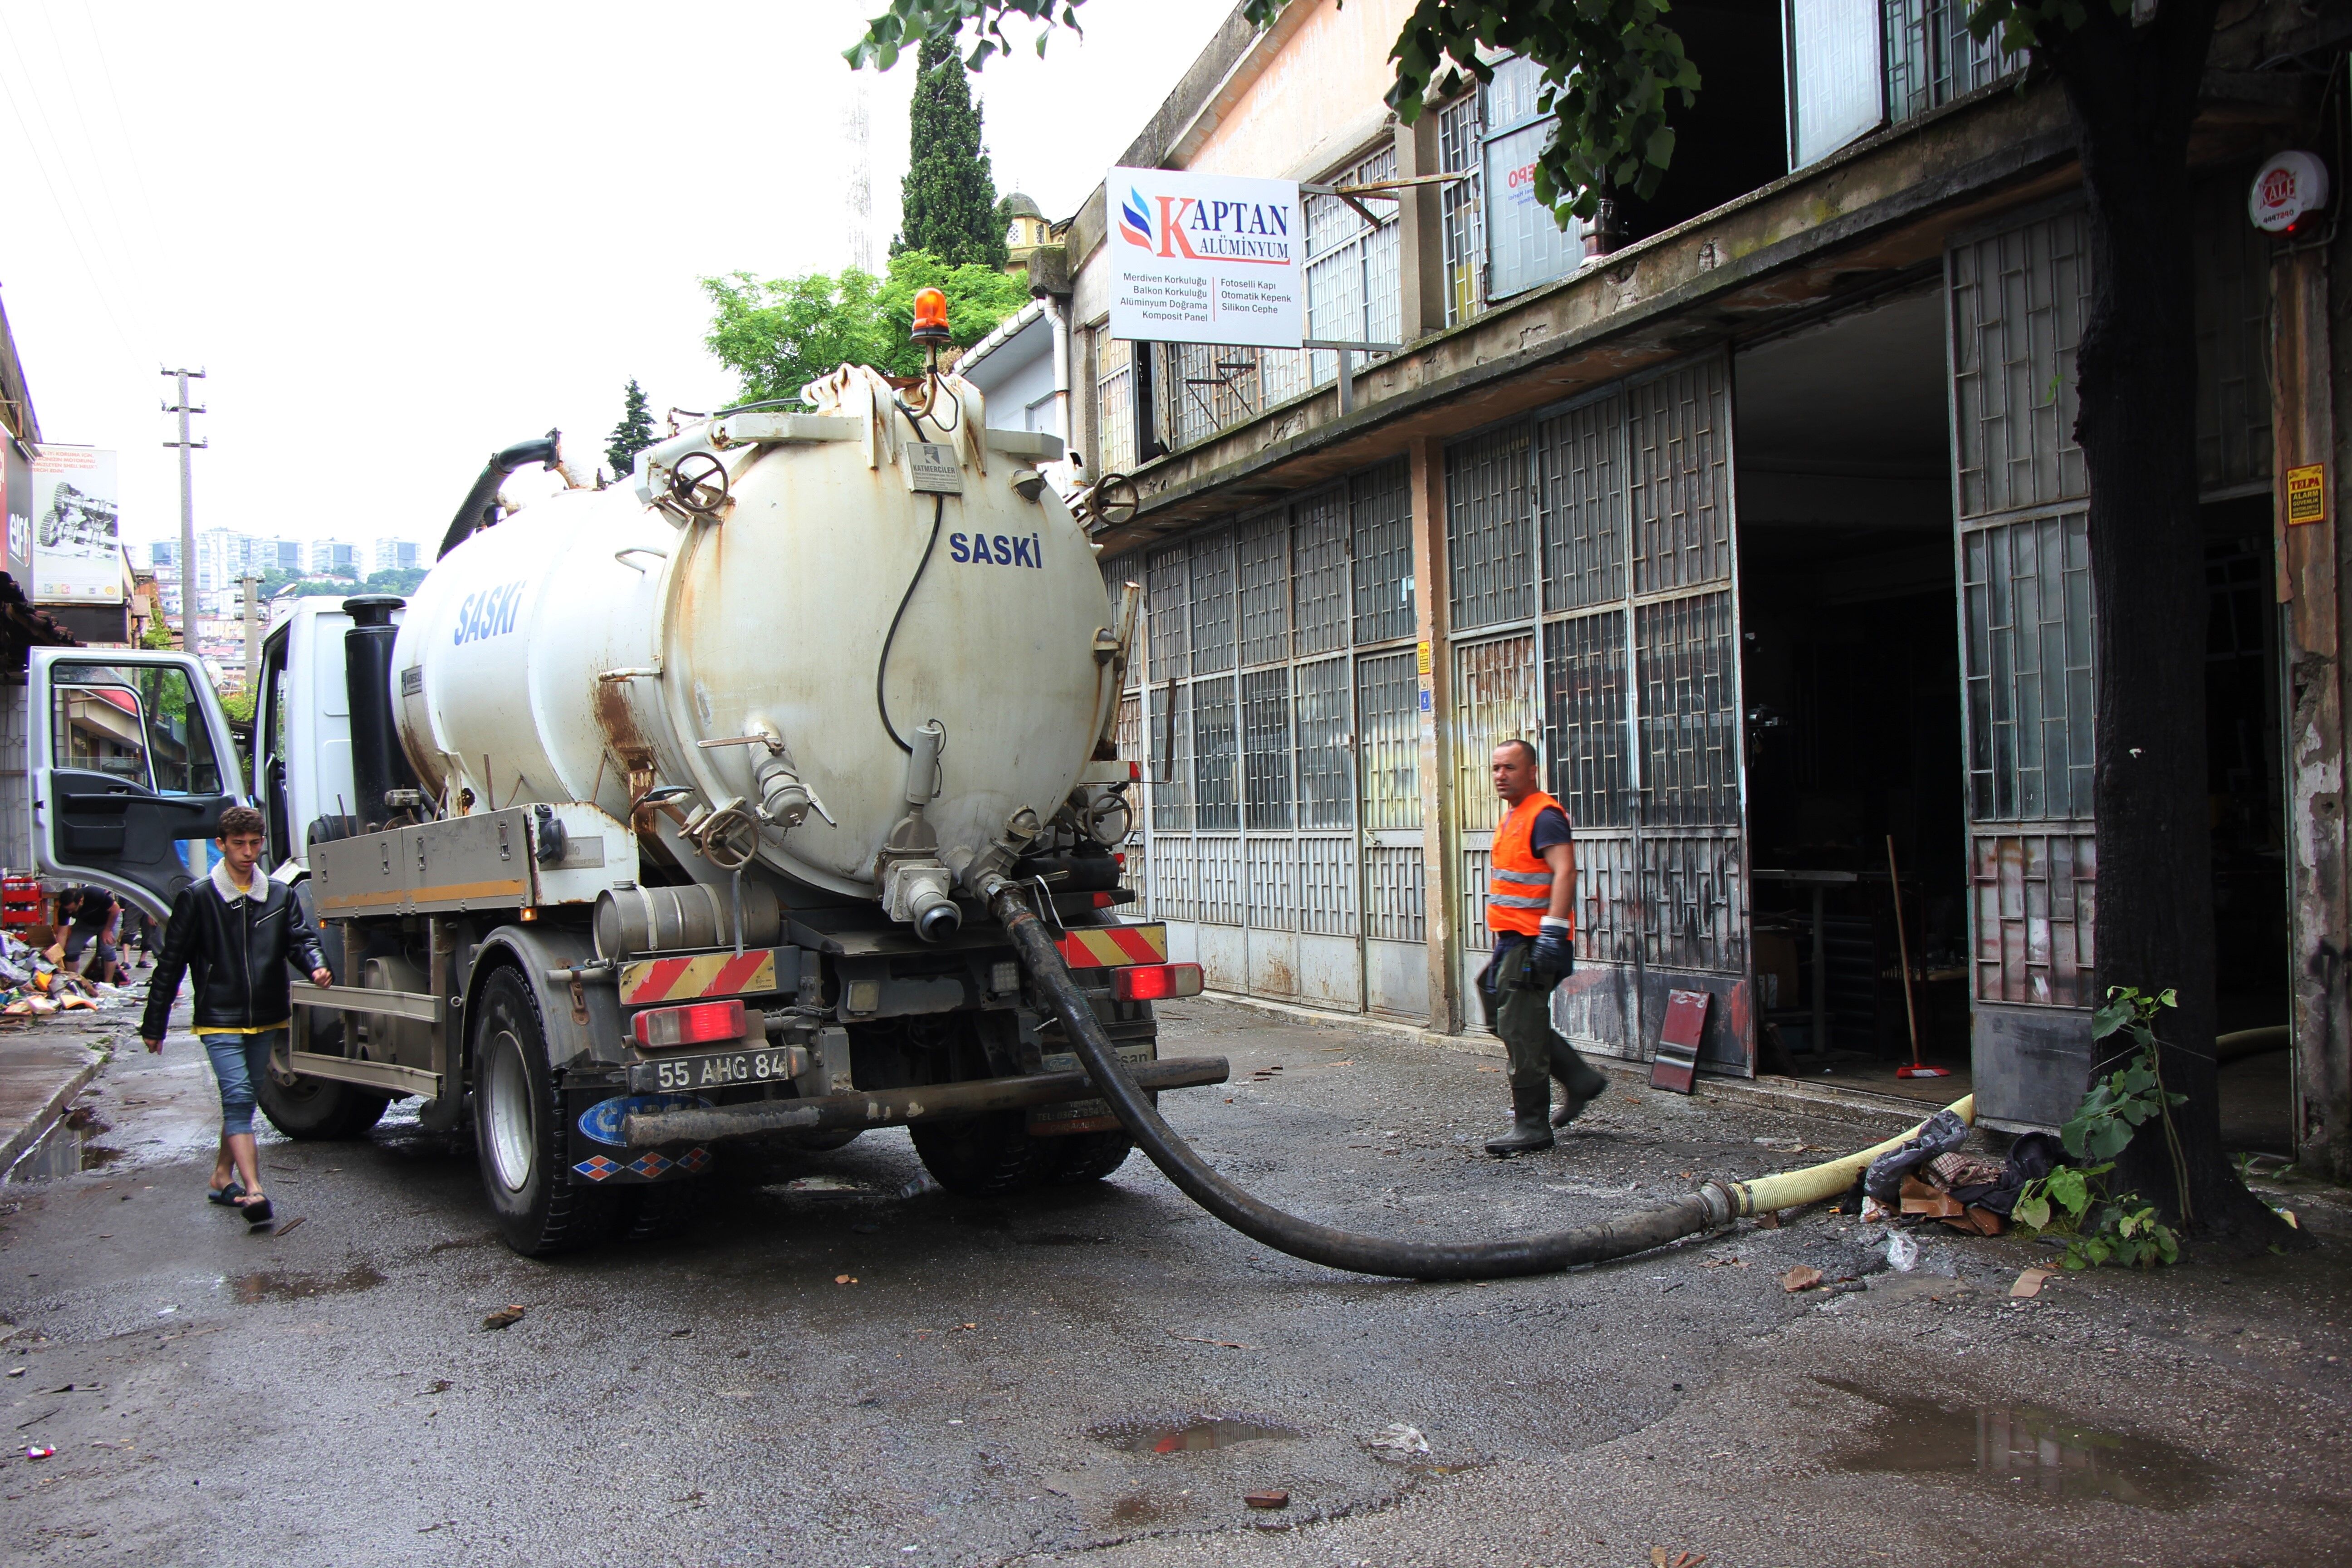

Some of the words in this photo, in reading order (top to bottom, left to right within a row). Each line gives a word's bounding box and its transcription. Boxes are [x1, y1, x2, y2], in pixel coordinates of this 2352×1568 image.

[2259, 177, 2296, 209] KALE
[2263, 210, 2294, 224] 4447240
[1155, 196, 1289, 259] KAPTAN
[1200, 235, 1289, 259] ALÜMİNYUM
[1123, 273, 1162, 283] Merdiven
[1165, 275, 1207, 287] Korkuluğu
[1221, 278, 1255, 288] Fotoselli
[1258, 281, 1276, 291] Kapı
[1133, 285, 1162, 295] Balkon
[1165, 287, 1207, 299] Korkuluğu
[1221, 290, 1259, 300] Otomatik
[1261, 293, 1292, 303] Kepenk
[1120, 297, 1167, 309] Alüminyum
[1170, 299, 1207, 310] Doğrama
[1222, 303, 1250, 312] Silikon
[1252, 304, 1278, 314] Cephe
[1142, 311, 1183, 321] Komposit
[1185, 313, 1208, 322] Panel
[913, 465, 956, 474] KATMERCİLER
[2290, 476, 2320, 490] TELPA
[2293, 490, 2318, 500] ALARM
[950, 532, 1042, 569] SASKİ
[454, 580, 527, 646] SASKİ
[659, 1062, 690, 1088] 55
[701, 1056, 748, 1084] AHG
[755, 1054, 785, 1078] 84
